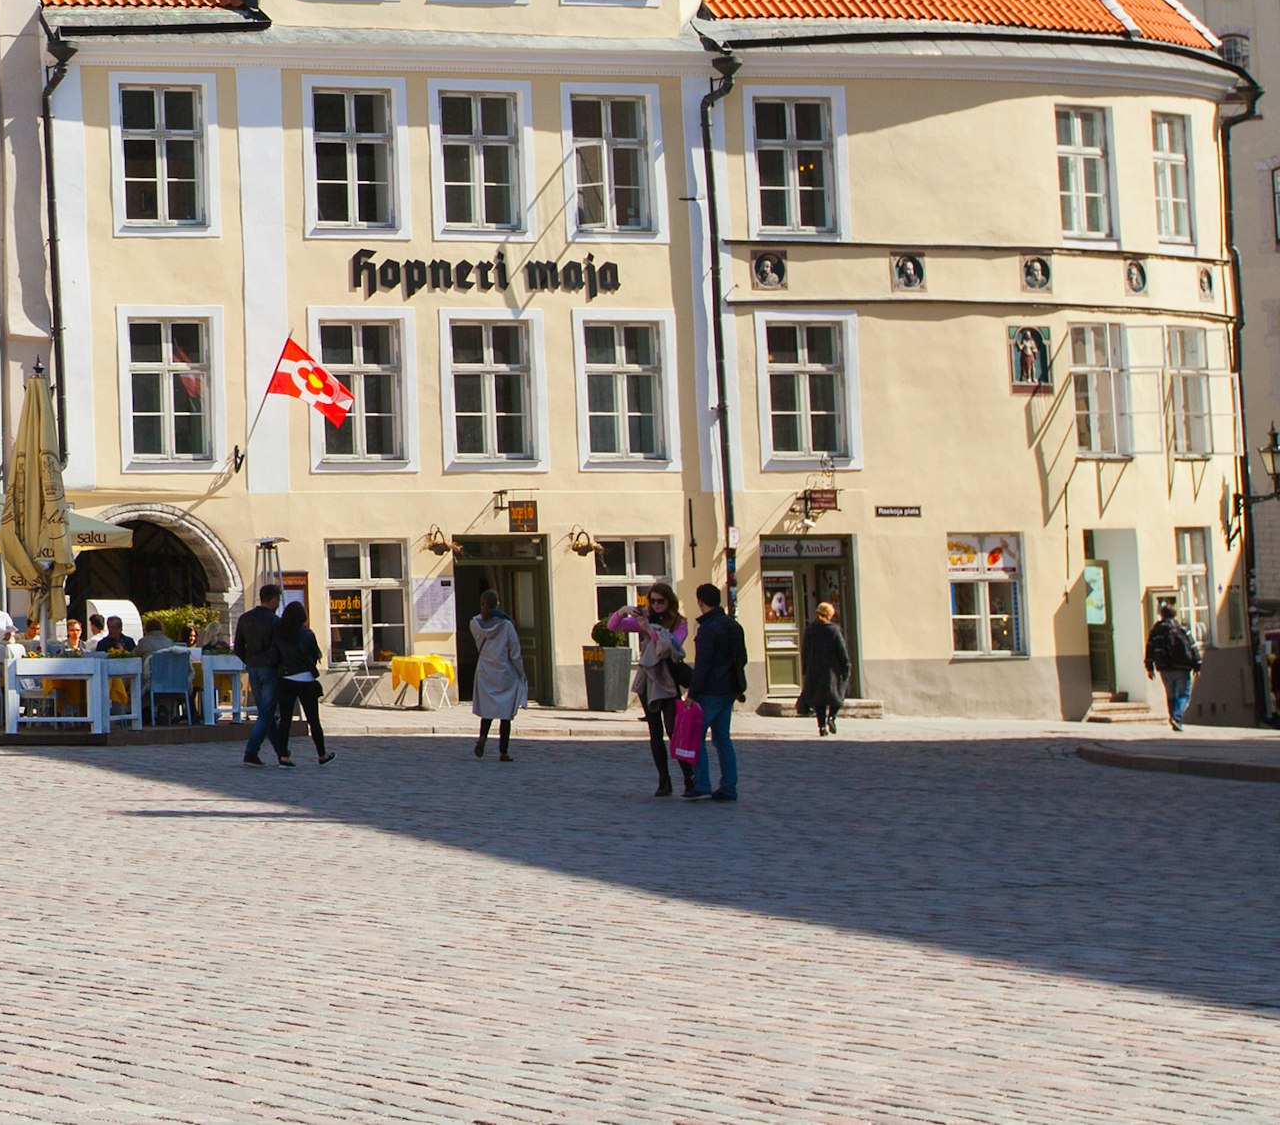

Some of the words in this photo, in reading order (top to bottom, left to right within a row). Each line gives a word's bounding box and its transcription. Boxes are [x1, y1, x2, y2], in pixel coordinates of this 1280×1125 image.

[525, 252, 621, 300] maja
[878, 507, 903, 516] Raekoja
[904, 507, 920, 516] plats
[77, 530, 107, 544] saku
[764, 544, 790, 553] Baltic
[804, 544, 836, 553] Amber
